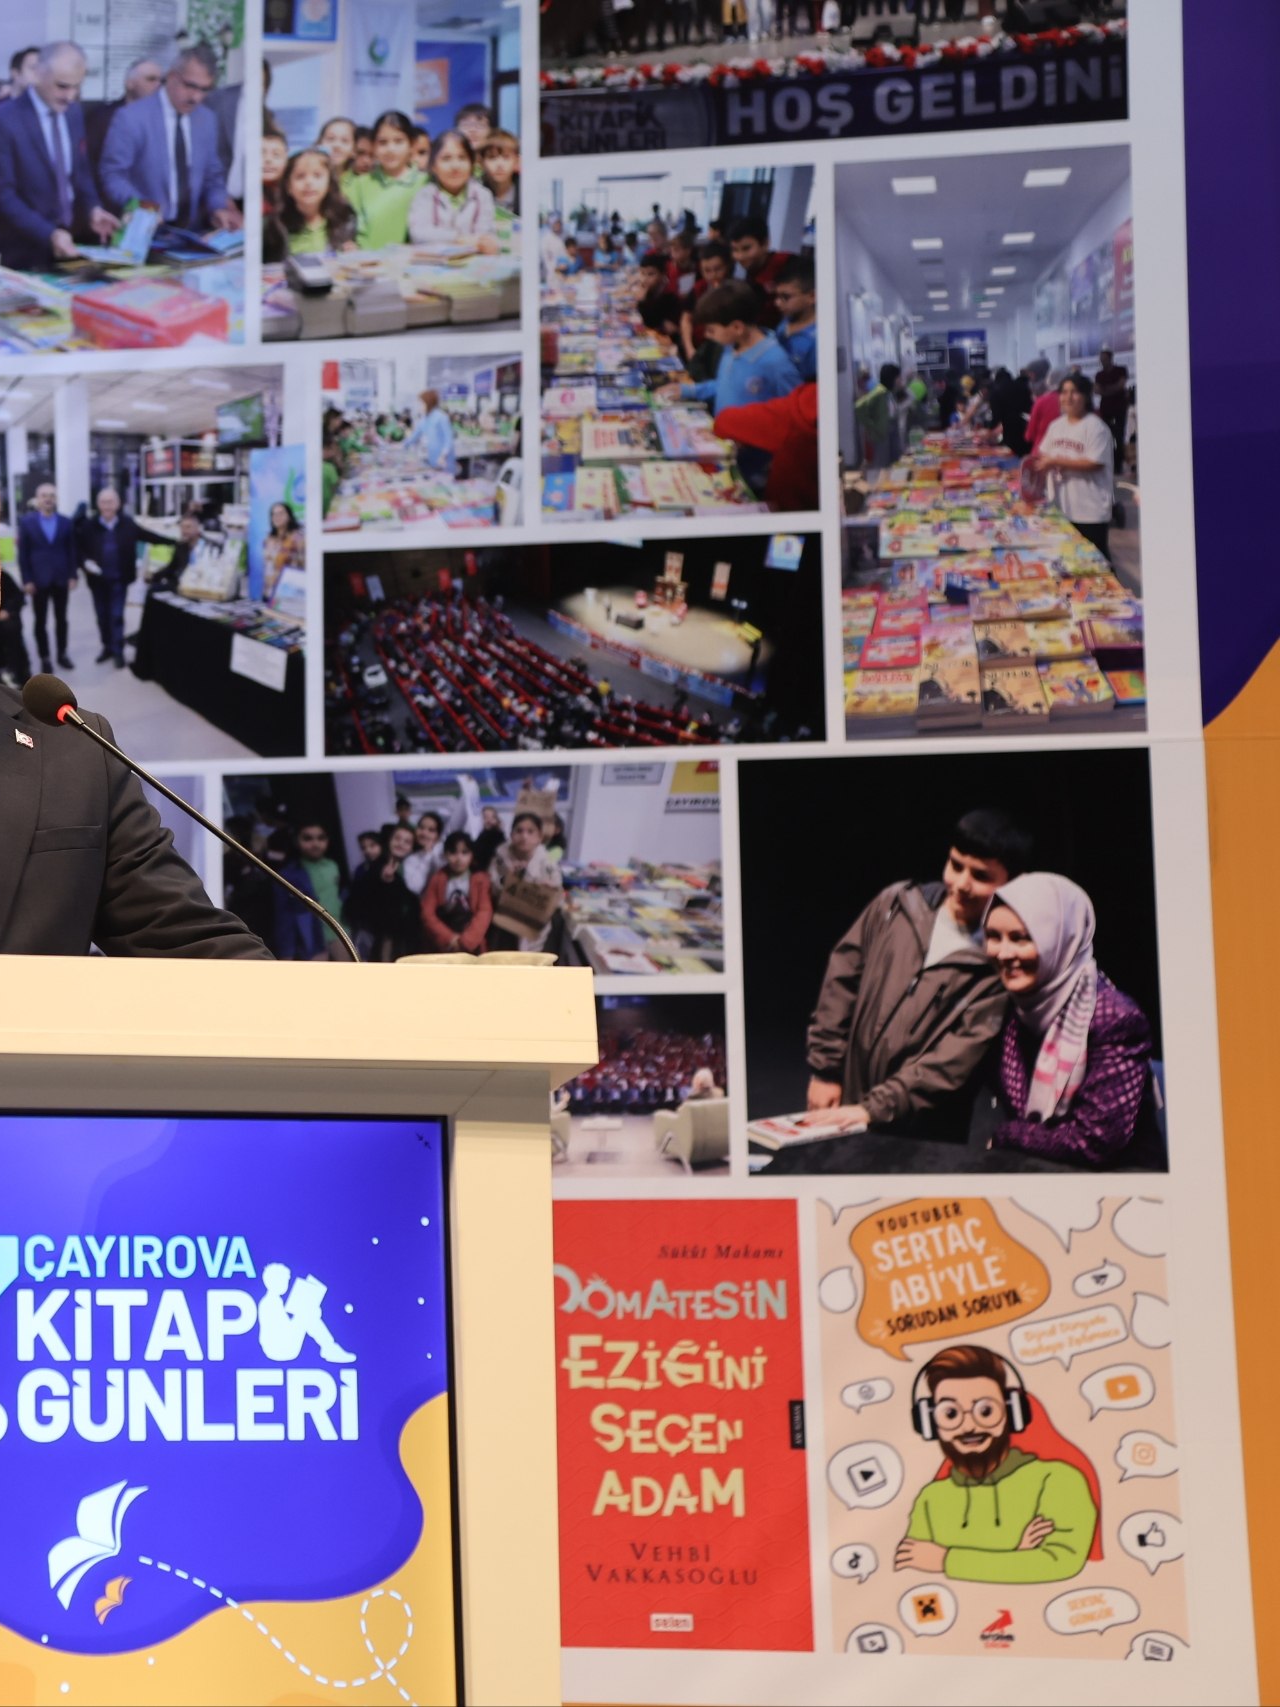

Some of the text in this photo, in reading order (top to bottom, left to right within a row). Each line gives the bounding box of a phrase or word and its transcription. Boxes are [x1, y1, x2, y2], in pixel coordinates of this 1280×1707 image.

[726, 81, 855, 136] HOŞ
[872, 1217, 987, 1273] SERTAÇ
[876, 1202, 963, 1234] YOUTUBER
[23, 1235, 257, 1282] ÇAYIROVA
[16, 1288, 258, 1362] KİTAP
[886, 1287, 1023, 1337] SORUDAN SORUYA
[560, 1333, 768, 1391] EZİĞİNİ
[17, 1368, 360, 1443] GÜNLERİ
[590, 1402, 744, 1458] SEÇEN
[592, 1467, 746, 1518] ADAM
